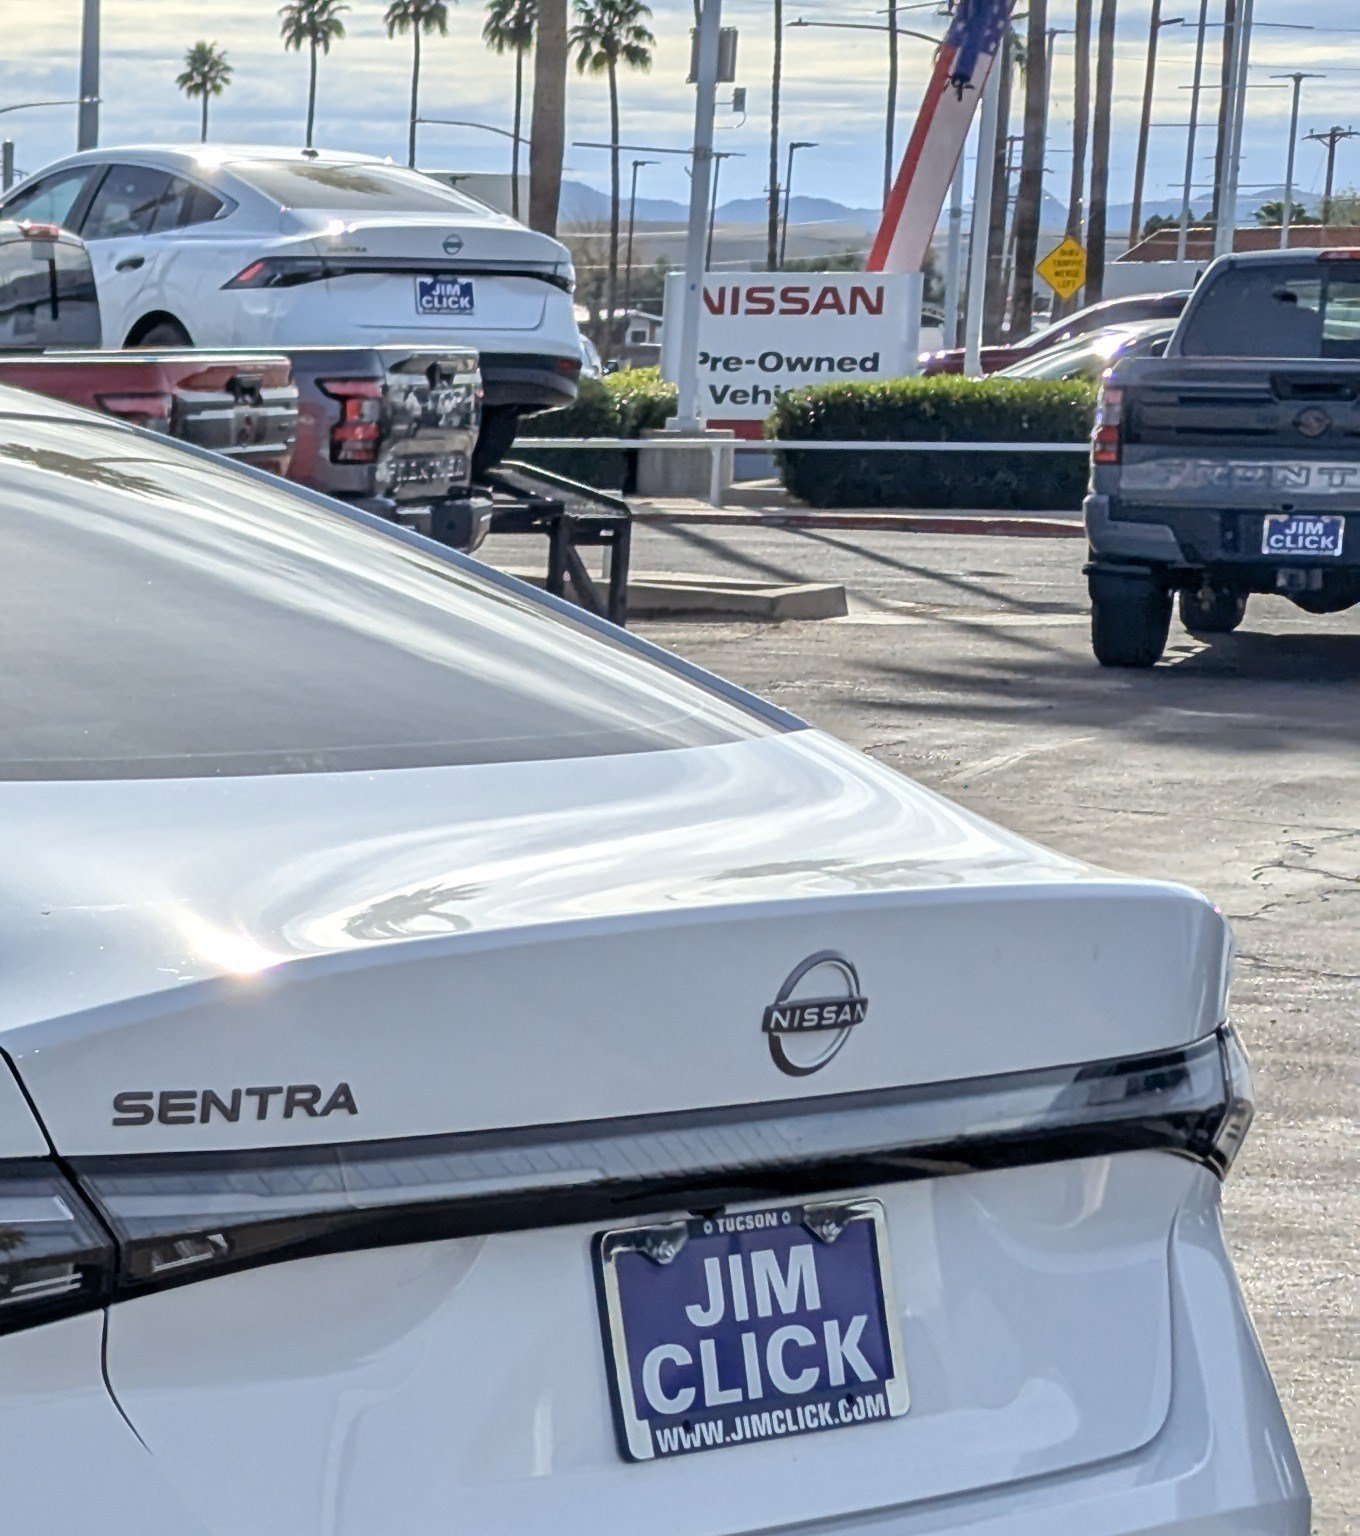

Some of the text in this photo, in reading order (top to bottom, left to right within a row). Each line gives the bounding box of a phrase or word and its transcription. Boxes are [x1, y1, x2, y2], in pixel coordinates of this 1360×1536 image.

[421, 296, 471, 309] CLICK
[431, 283, 461, 296] JIM
[703, 286, 884, 315] NISSAN
[1285, 521, 1324, 535] JIM
[1269, 535, 1334, 549] CLICK
[770, 1003, 867, 1029] NISSAN
[112, 1082, 358, 1126] SENTRA
[716, 1211, 777, 1233] TUCSON
[685, 1244, 821, 1327] JIM
[642, 1314, 877, 1415] CLICK
[656, 1392, 886, 1453] WWW.JIMCLICK.COM
